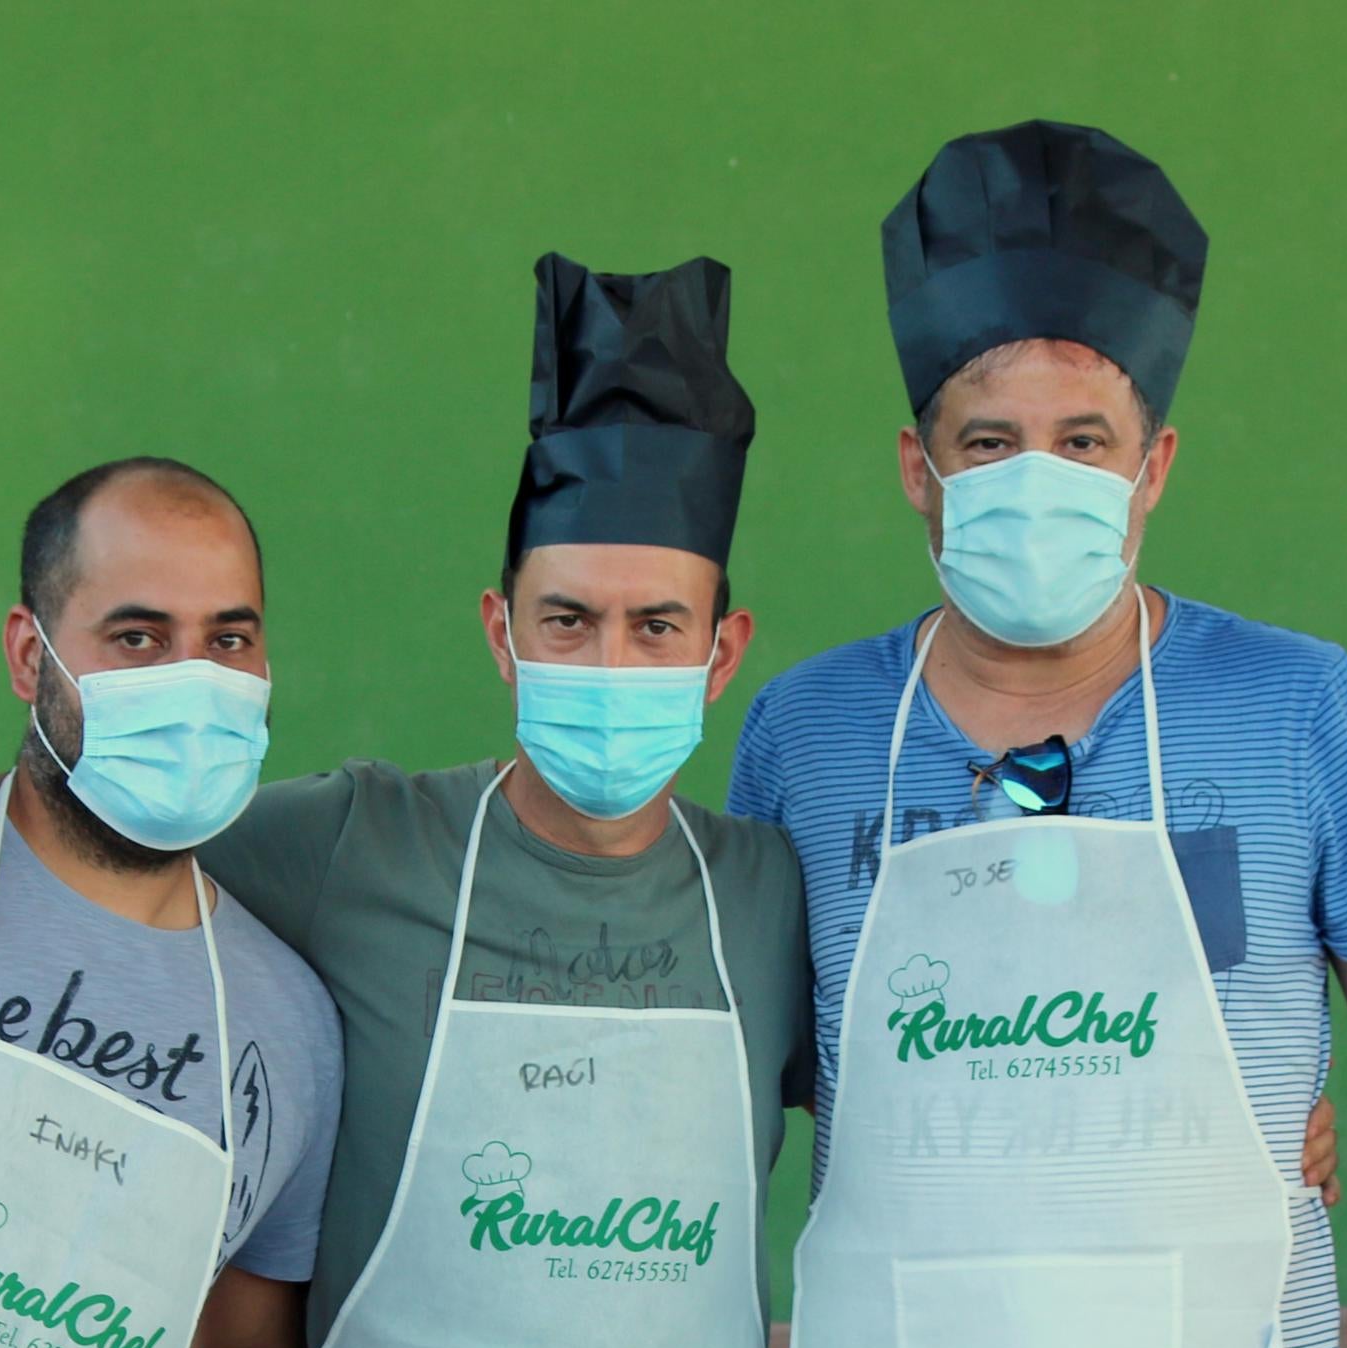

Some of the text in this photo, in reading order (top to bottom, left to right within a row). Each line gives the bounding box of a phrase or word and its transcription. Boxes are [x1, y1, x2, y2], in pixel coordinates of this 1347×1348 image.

[36, 969, 205, 1102] best
[966, 1055, 1122, 1080] Tel. 627455551
[545, 1257, 689, 1283] Tel. 627455551
